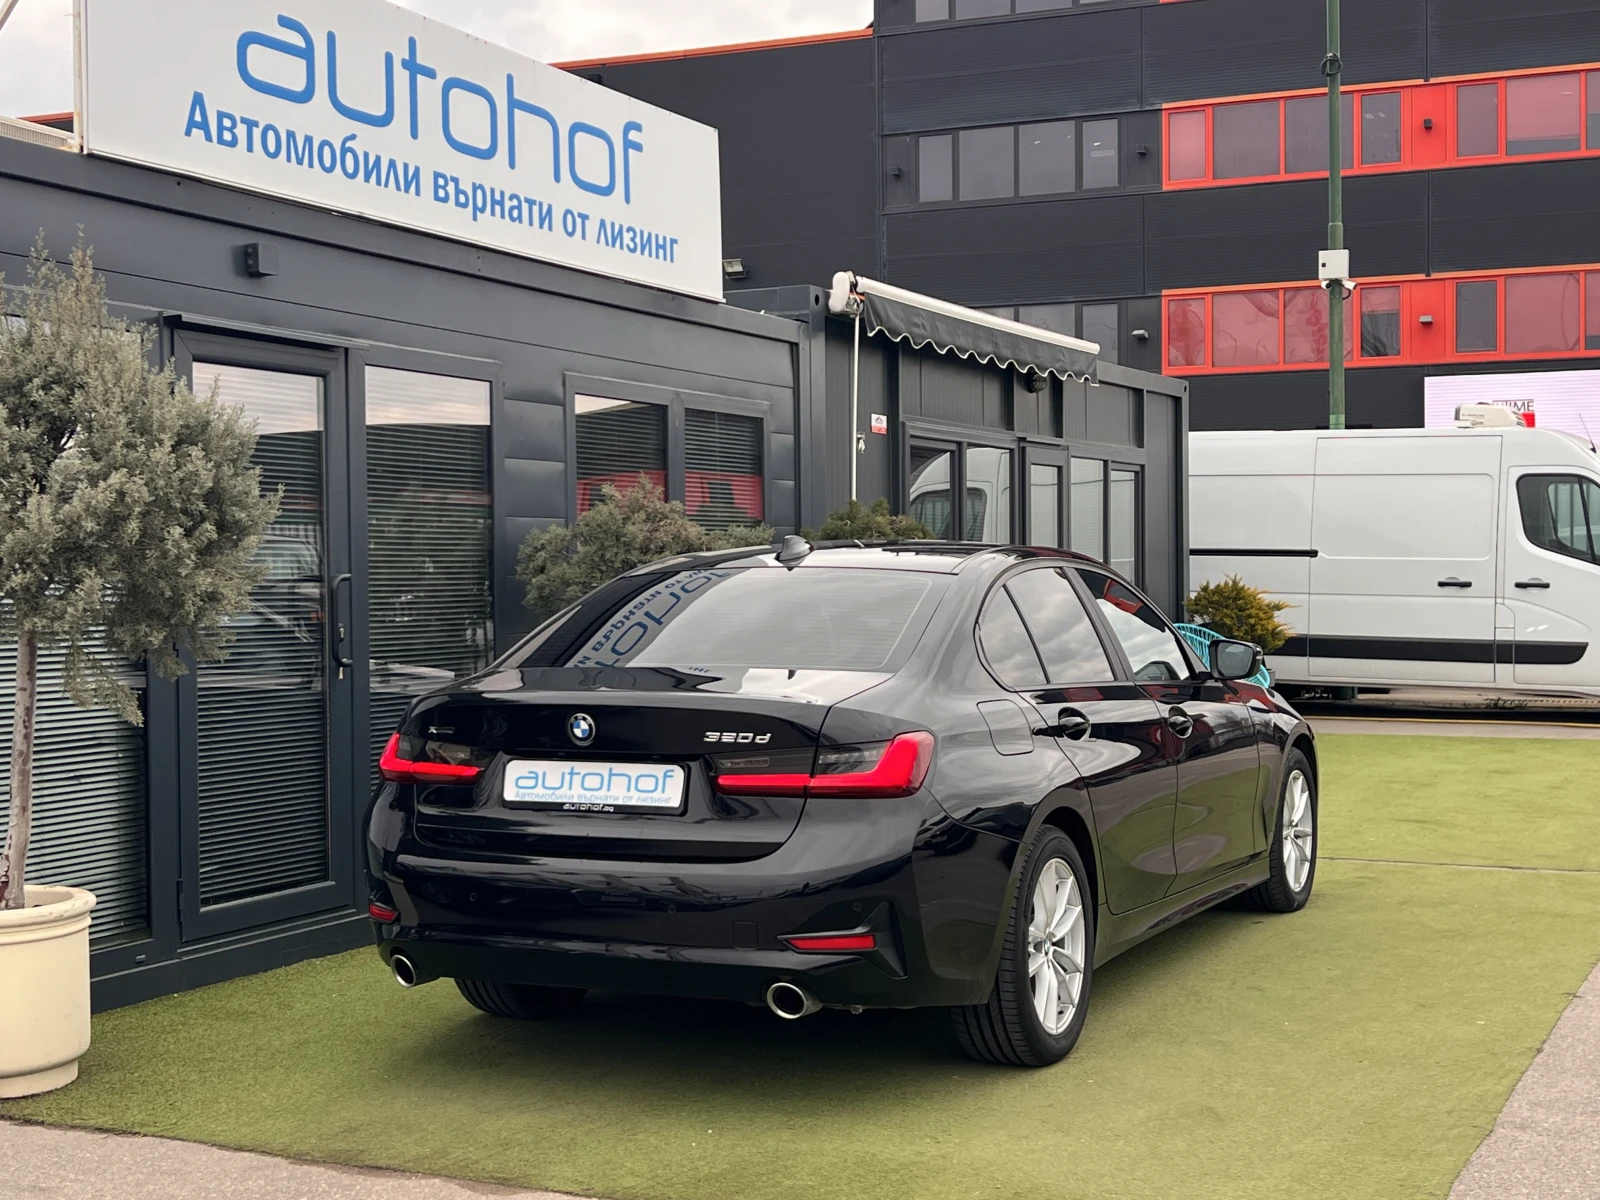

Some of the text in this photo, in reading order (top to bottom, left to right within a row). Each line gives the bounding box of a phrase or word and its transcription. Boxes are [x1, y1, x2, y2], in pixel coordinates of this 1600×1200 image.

[236, 14, 643, 204] autohof
[184, 91, 678, 263] Автомобили върнати от лизинг
[703, 731, 772, 743] 320d
[514, 766, 675, 794] autohof
[514, 790, 672, 805] Автомобили върнати от лизинг
